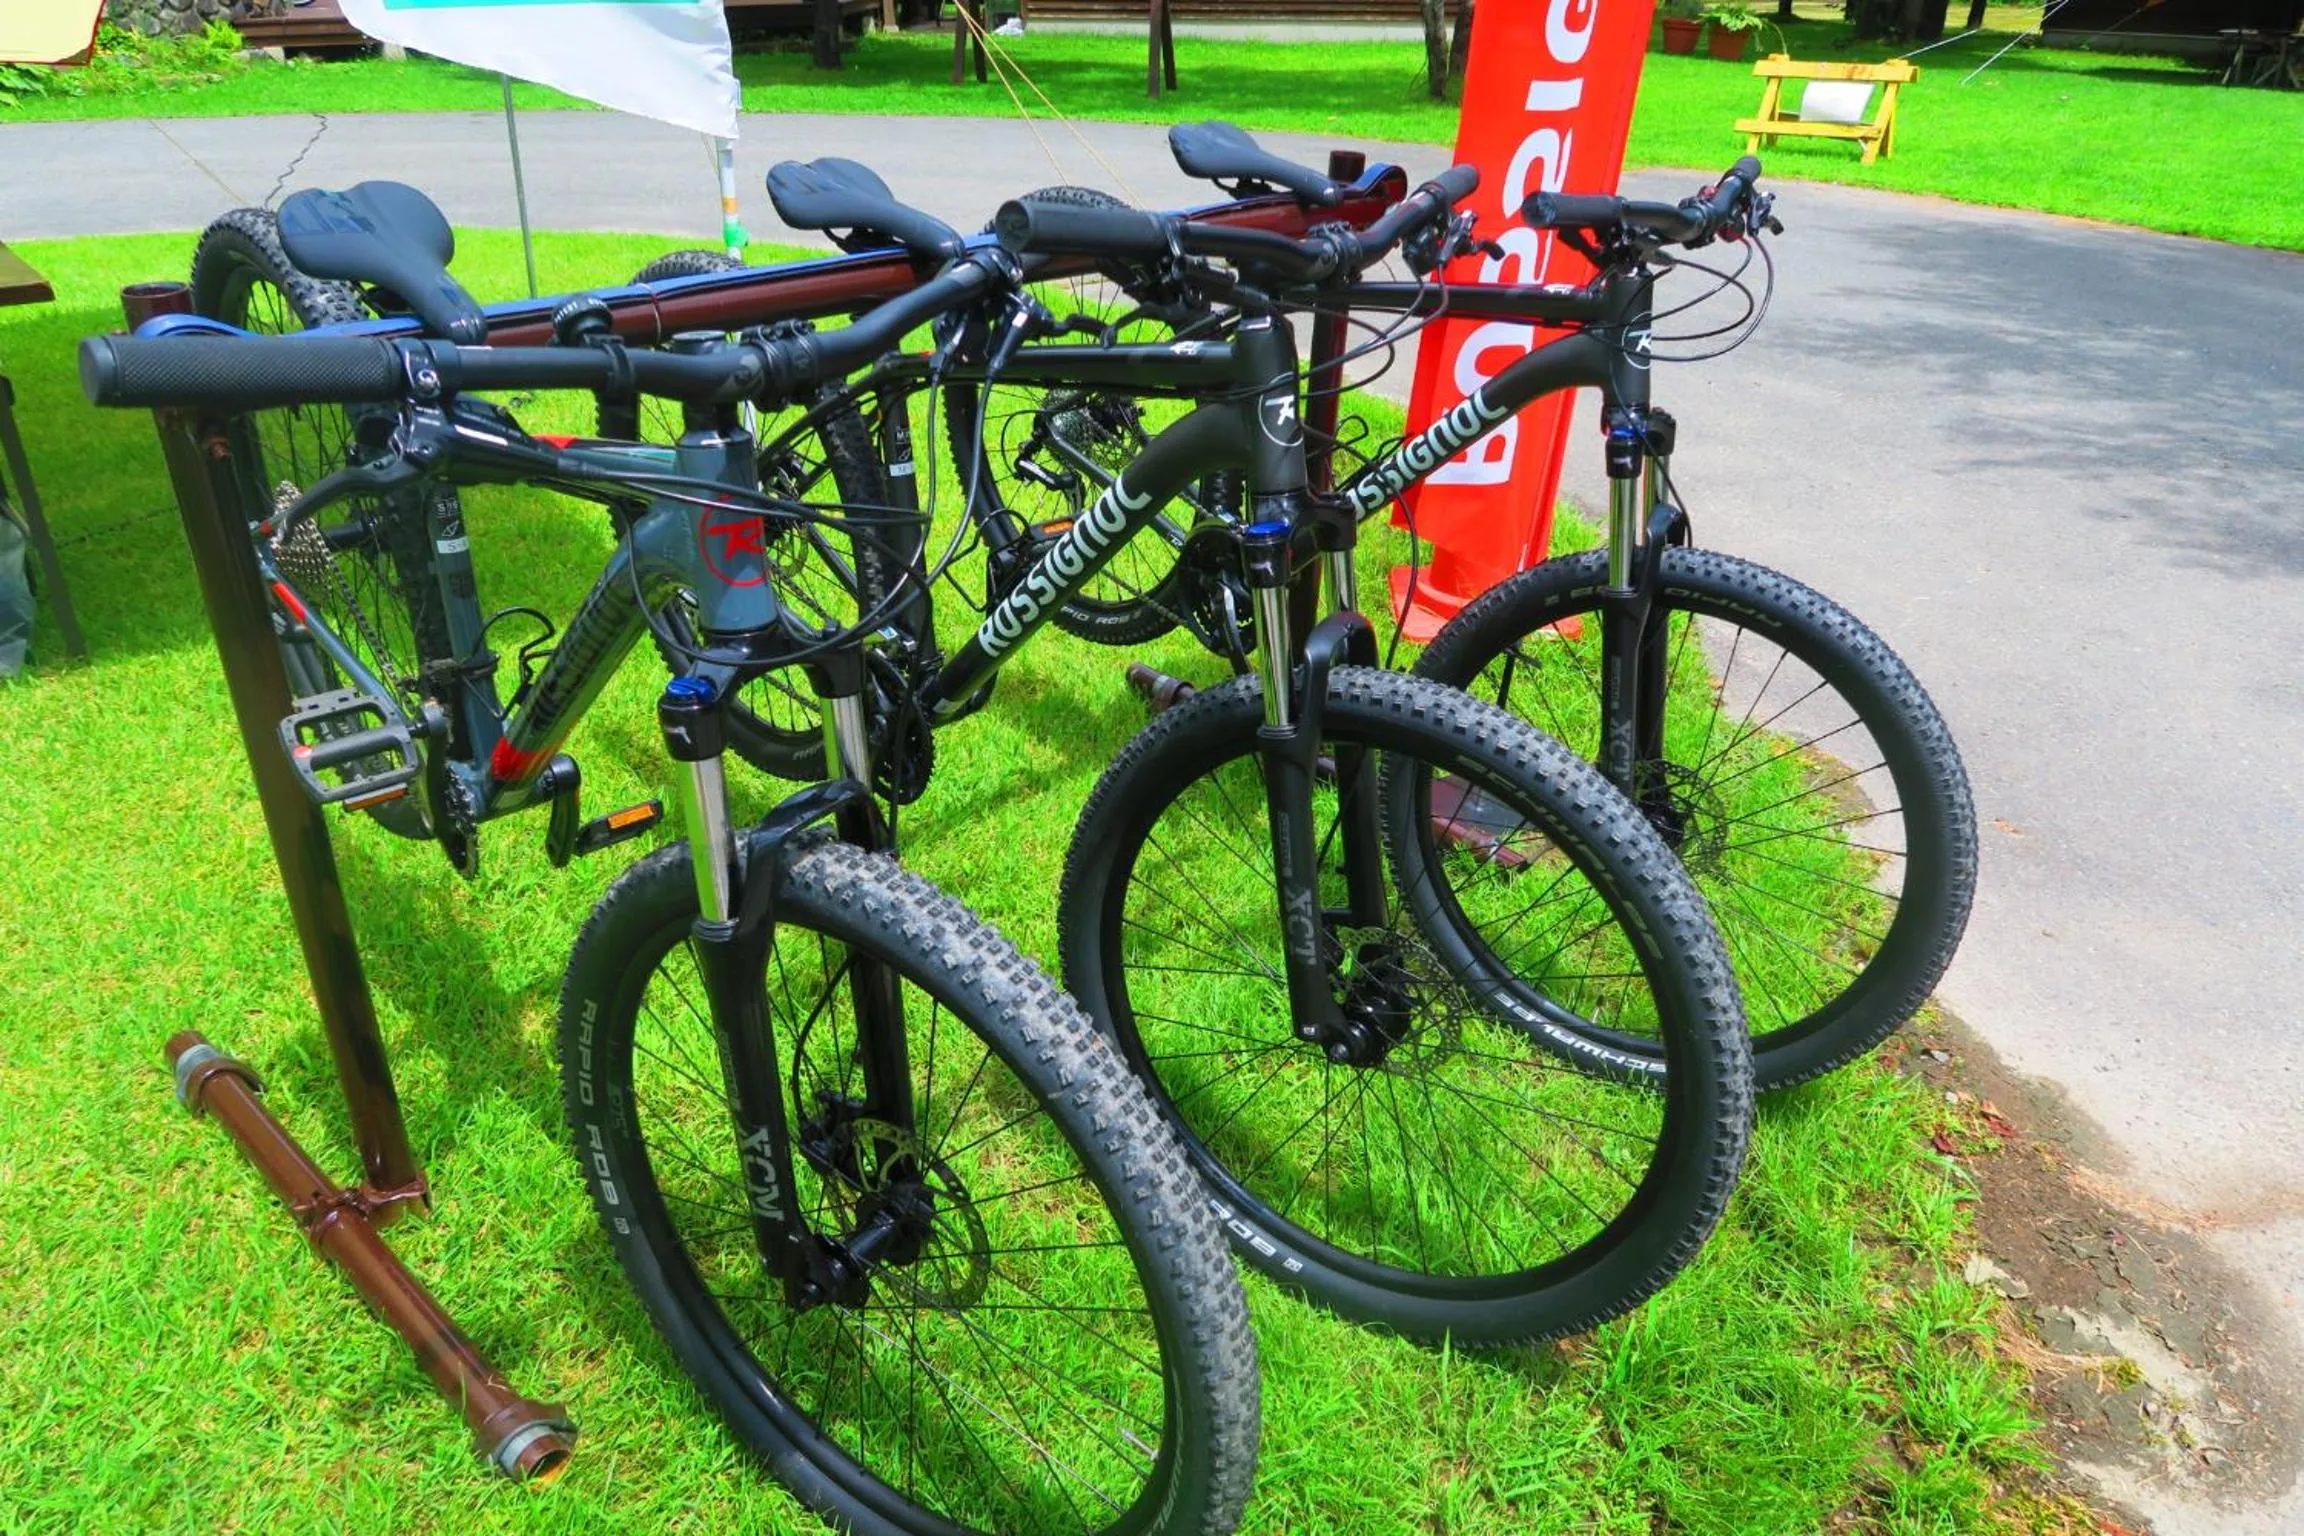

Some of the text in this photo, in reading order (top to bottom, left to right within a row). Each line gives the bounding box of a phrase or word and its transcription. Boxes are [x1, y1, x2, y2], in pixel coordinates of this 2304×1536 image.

[977, 475, 1153, 658] ROSSIGNOL
[577, 999, 600, 1107] RAPID
[584, 1123, 621, 1206] ROB
